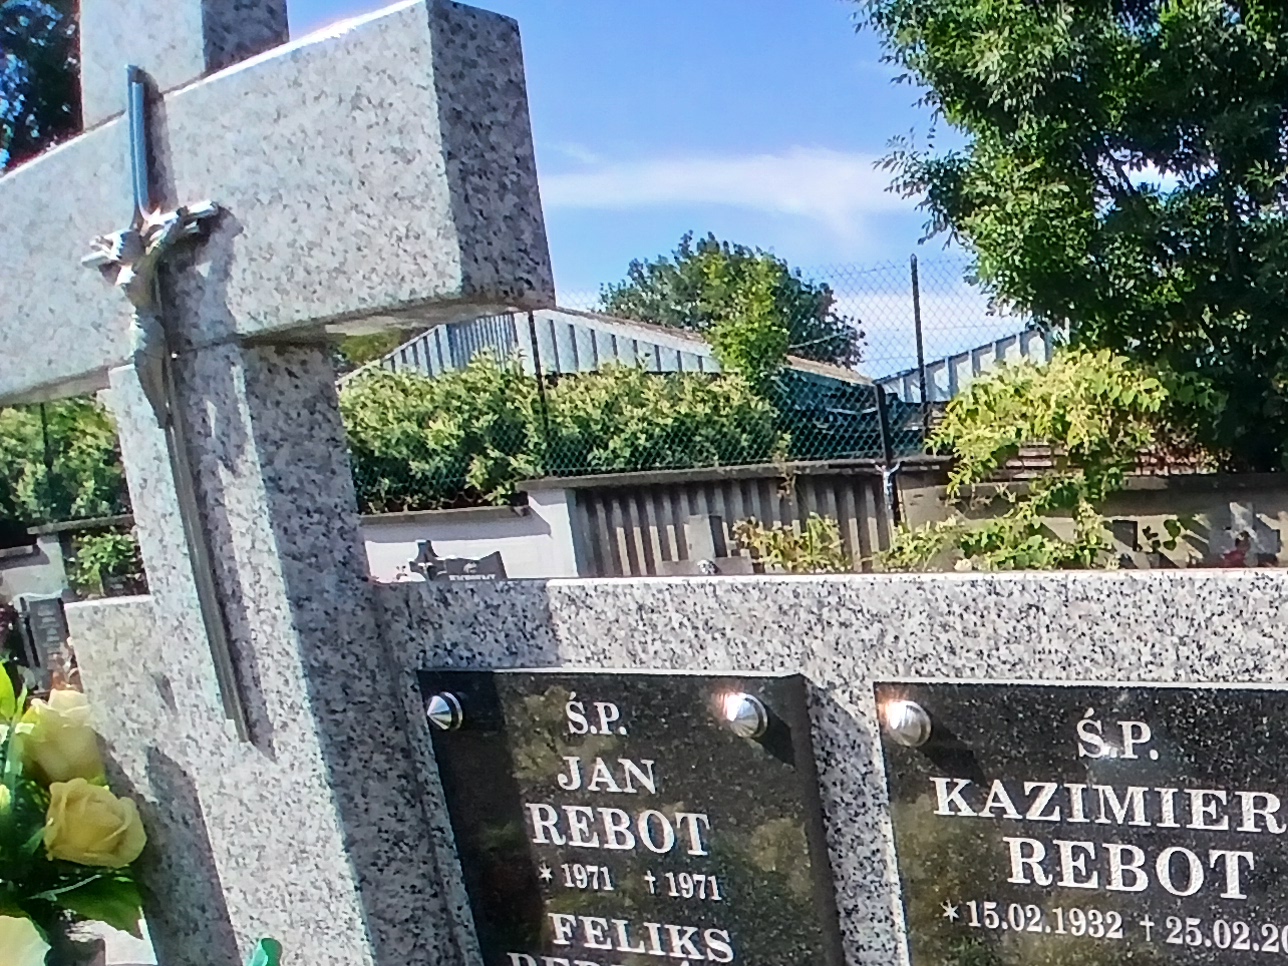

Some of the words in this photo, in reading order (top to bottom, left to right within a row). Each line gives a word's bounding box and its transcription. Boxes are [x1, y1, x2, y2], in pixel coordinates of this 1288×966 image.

[565, 692, 627, 735] Ś.P.
[1076, 708, 1160, 761] Ś.P.
[557, 756, 656, 794] JAN
[525, 802, 711, 856] REBOT
[561, 863, 614, 891] 1971
[665, 871, 722, 901] 1971
[1003, 836, 1255, 900] REBOT
[547, 912, 735, 963] FELIKS
[967, 901, 1124, 940] 15.02.1932
